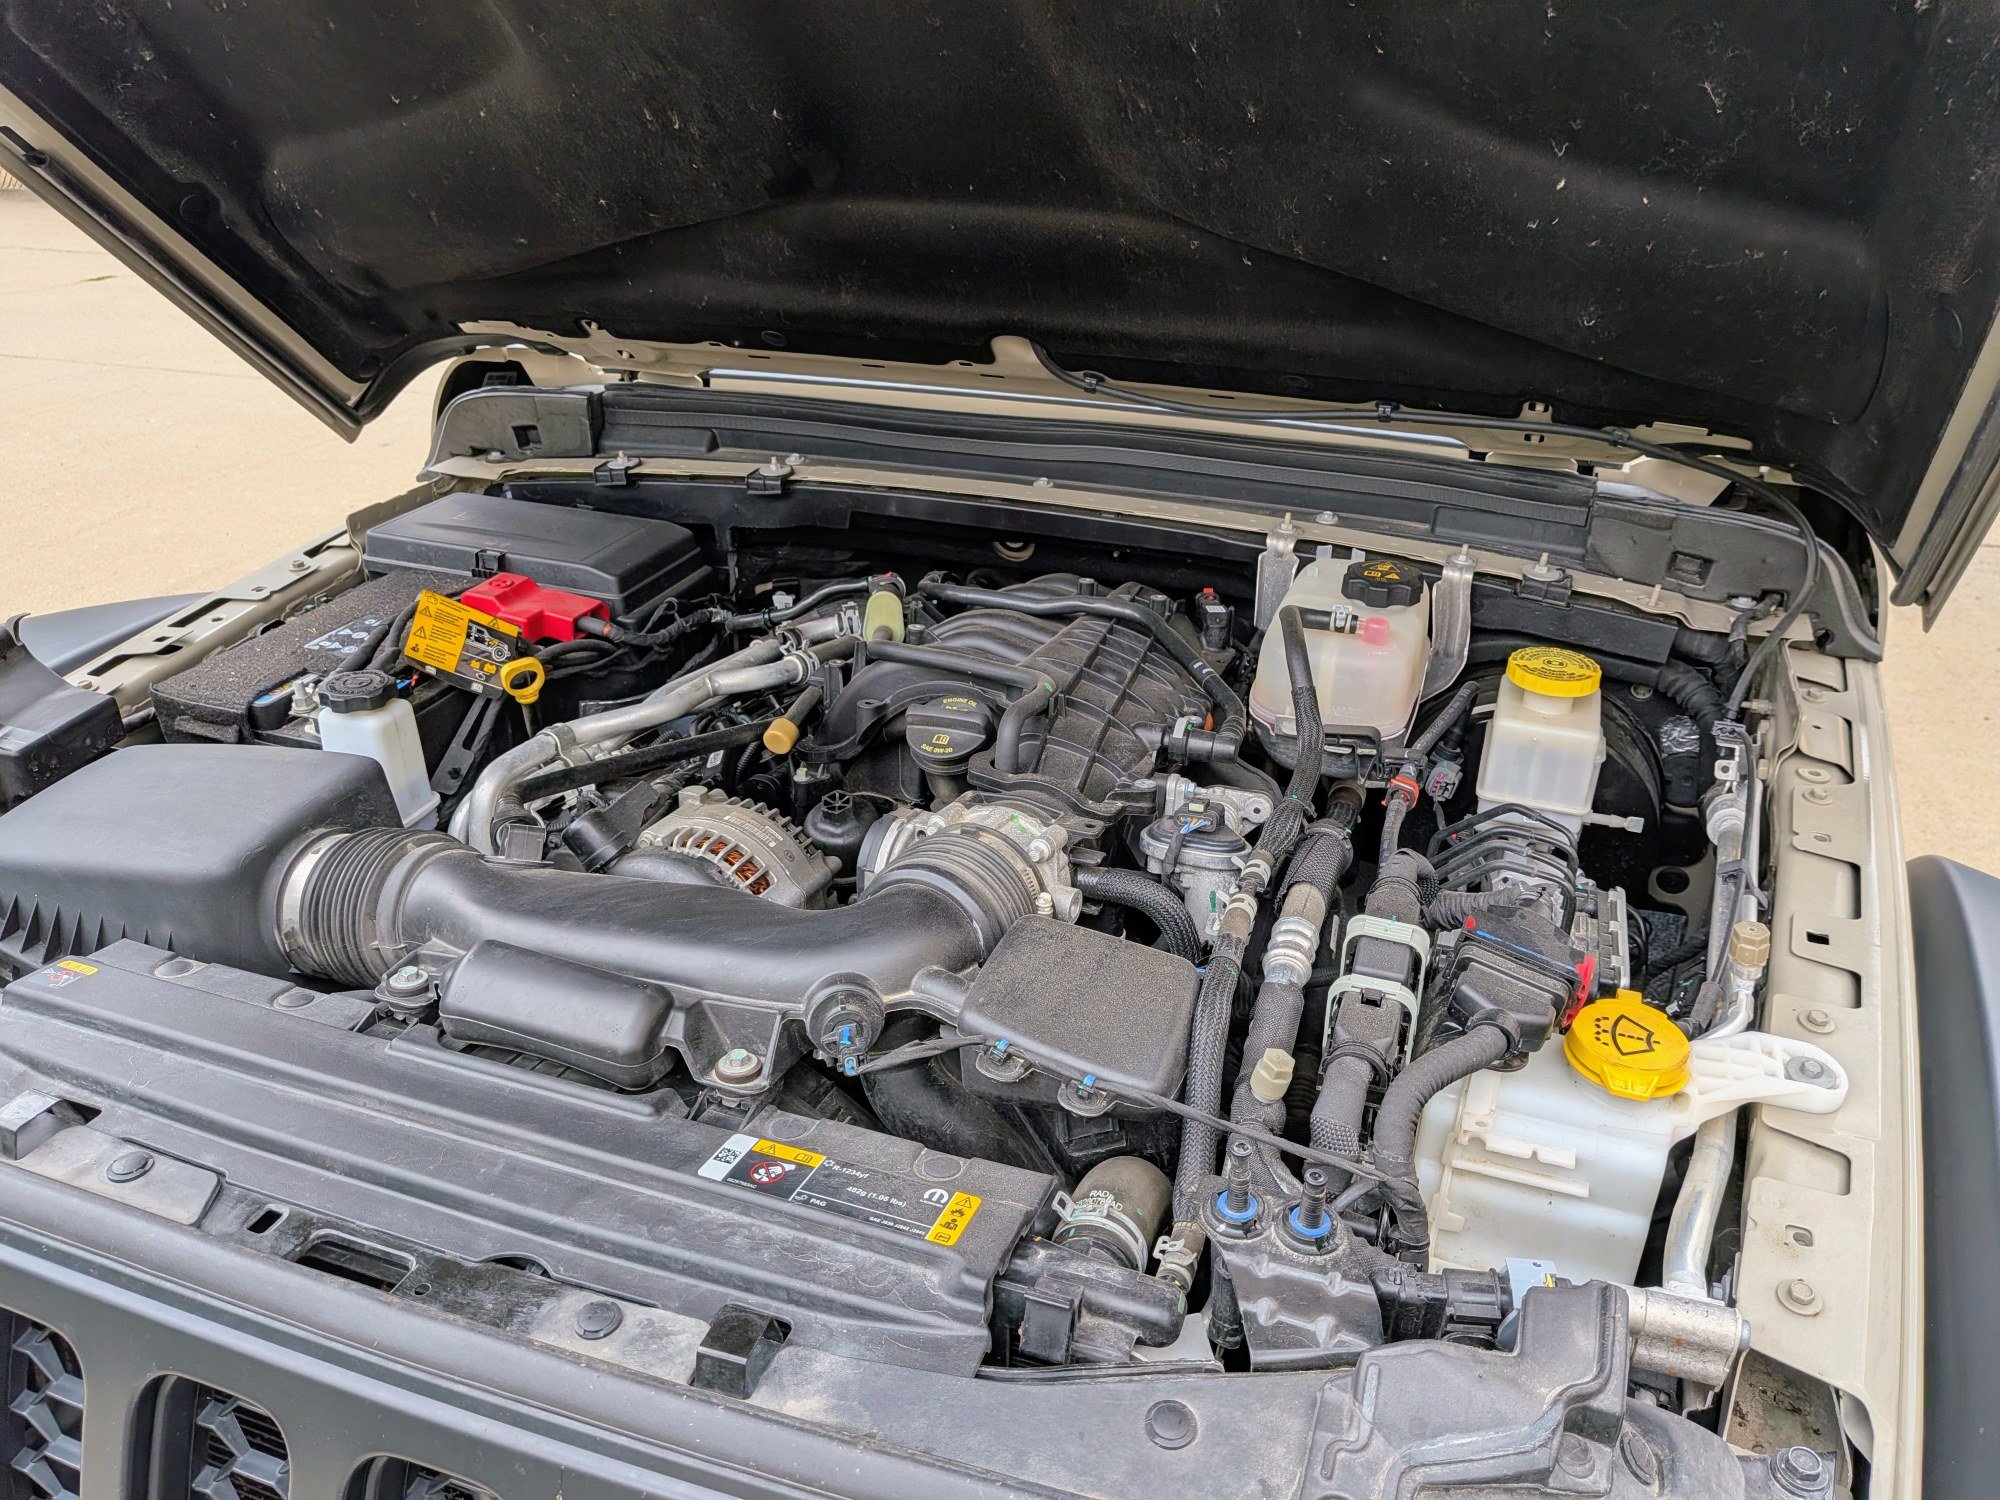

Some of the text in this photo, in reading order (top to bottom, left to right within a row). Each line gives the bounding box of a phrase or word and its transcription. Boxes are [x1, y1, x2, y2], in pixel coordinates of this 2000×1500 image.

[832, 1164, 870, 1179] R-1234yf
[809, 1197, 827, 1207] PAG
[867, 1191, 889, 1202] (1.06
[889, 1197, 907, 1208] lbs)
